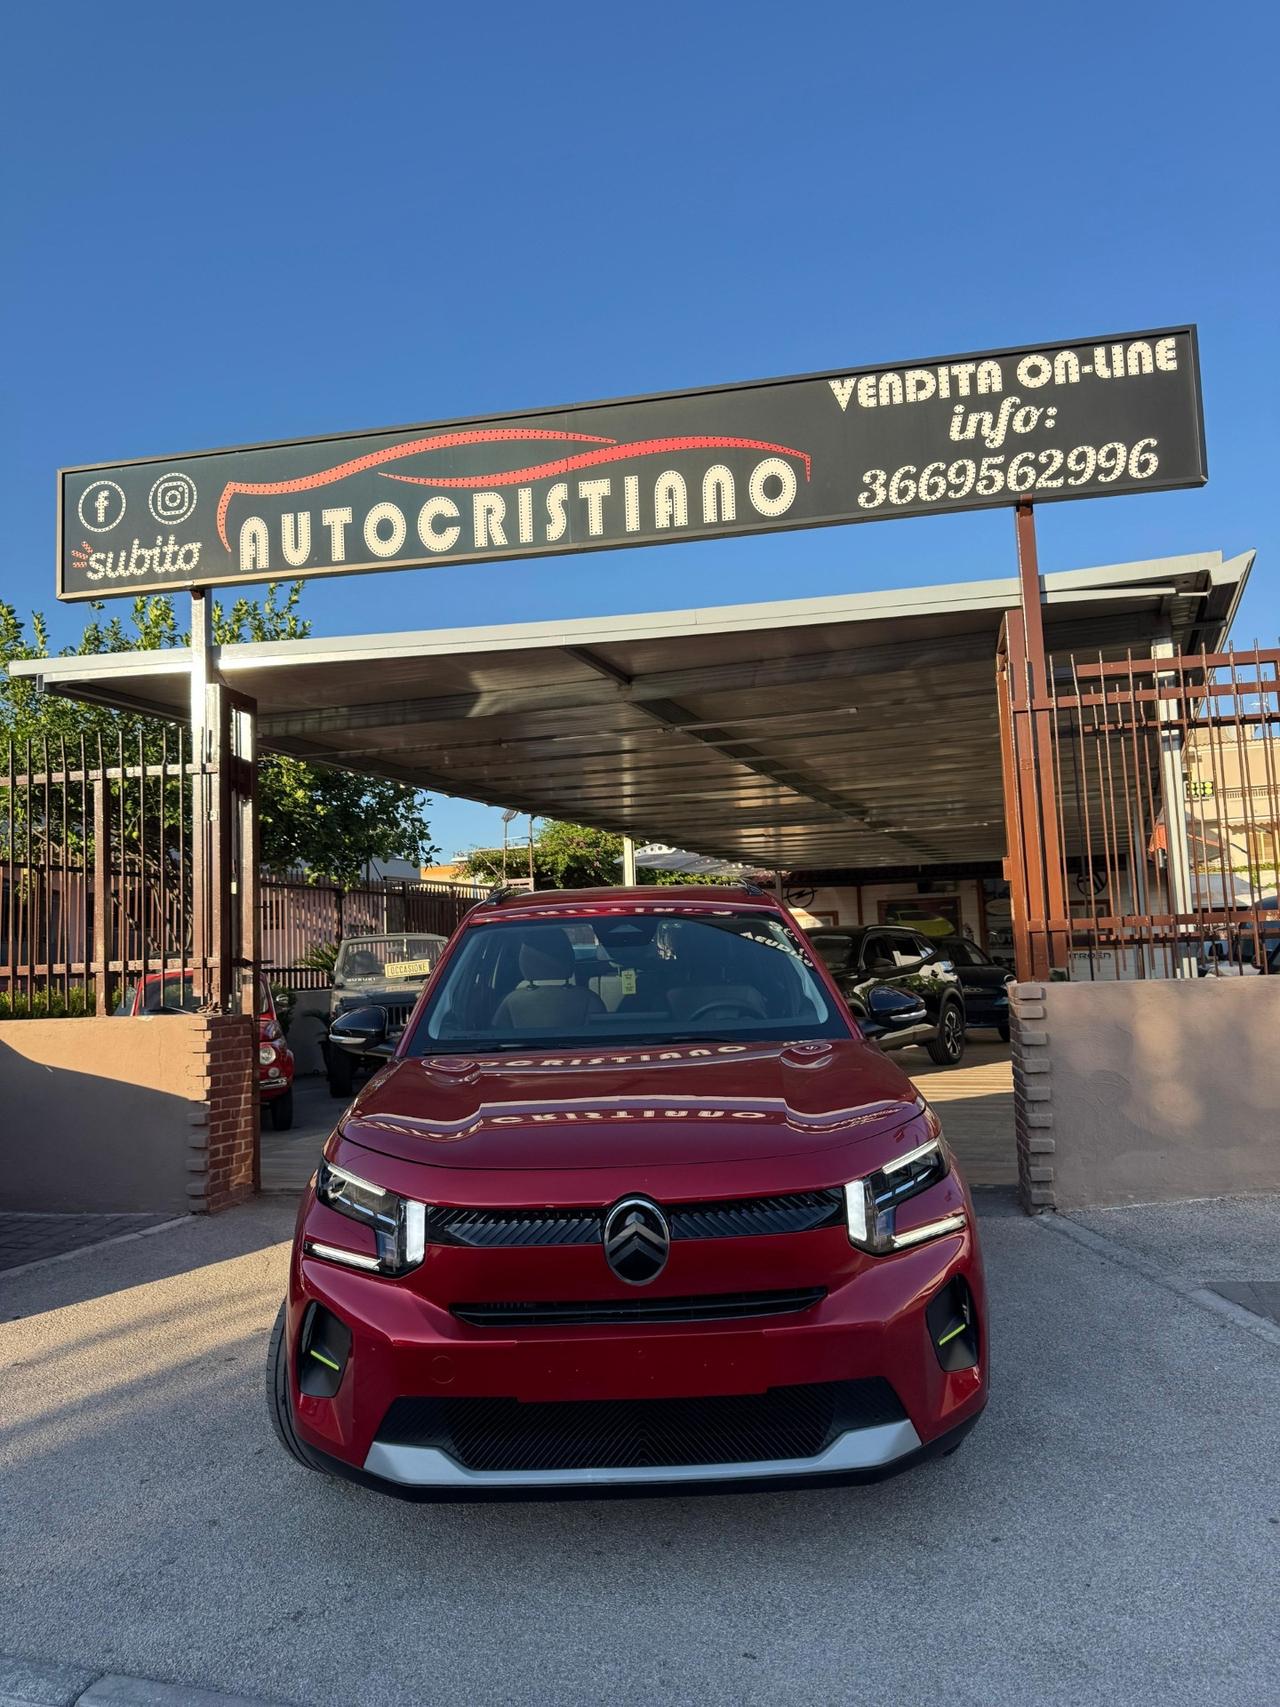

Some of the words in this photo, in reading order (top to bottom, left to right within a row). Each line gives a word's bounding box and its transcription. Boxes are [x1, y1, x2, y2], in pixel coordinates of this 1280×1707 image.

[829, 360, 1003, 412] VENDITA
[1016, 337, 1178, 389] ON-LINE
[949, 396, 1058, 449] info:
[857, 437, 1159, 509] 3669562996
[86, 534, 203, 581] subito
